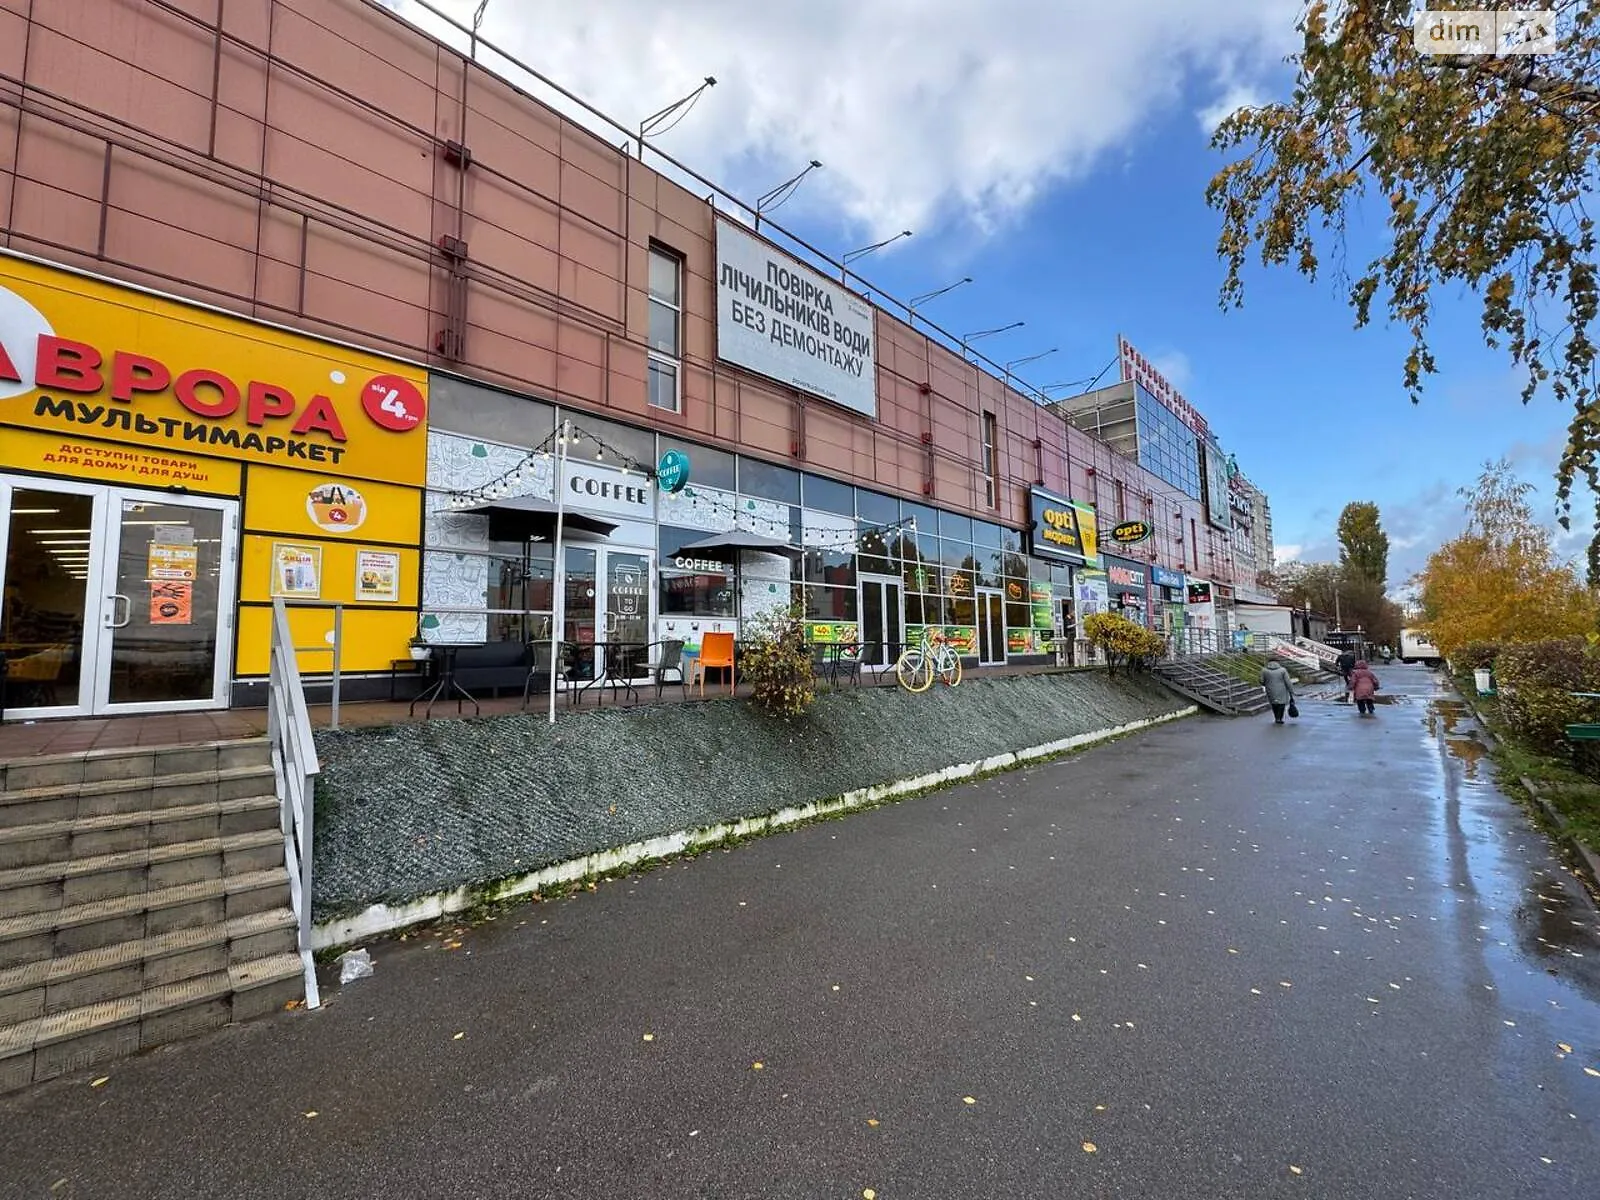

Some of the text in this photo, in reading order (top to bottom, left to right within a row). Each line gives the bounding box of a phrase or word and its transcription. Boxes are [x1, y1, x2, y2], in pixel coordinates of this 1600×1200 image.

[767, 260, 834, 316] ПОВІРКА
[720, 262, 830, 337] ЛІЧИЛЬНИКІВ
[833, 320, 871, 357] ВОДИ
[732, 299, 863, 377] БЕЗ ДЕМОНТАЖУ
[380, 389, 407, 418] 4
[34, 395, 346, 465] МУЛЬТИМАРКЕТ
[43, 452, 79, 464] ДЛЯ
[82, 458, 128, 472] ДОМУ
[138, 465, 169, 476] ДЛЯ
[172, 471, 209, 481] ДУШІ
[59, 444, 197, 470] ДОСТУПНІ ТОВАРИ
[660, 464, 681, 476] COFFEE
[570, 475, 647, 505] COFFEE
[1044, 508, 1074, 530] opti
[1115, 522, 1144, 536] opti
[675, 556, 724, 573] COFFEE
